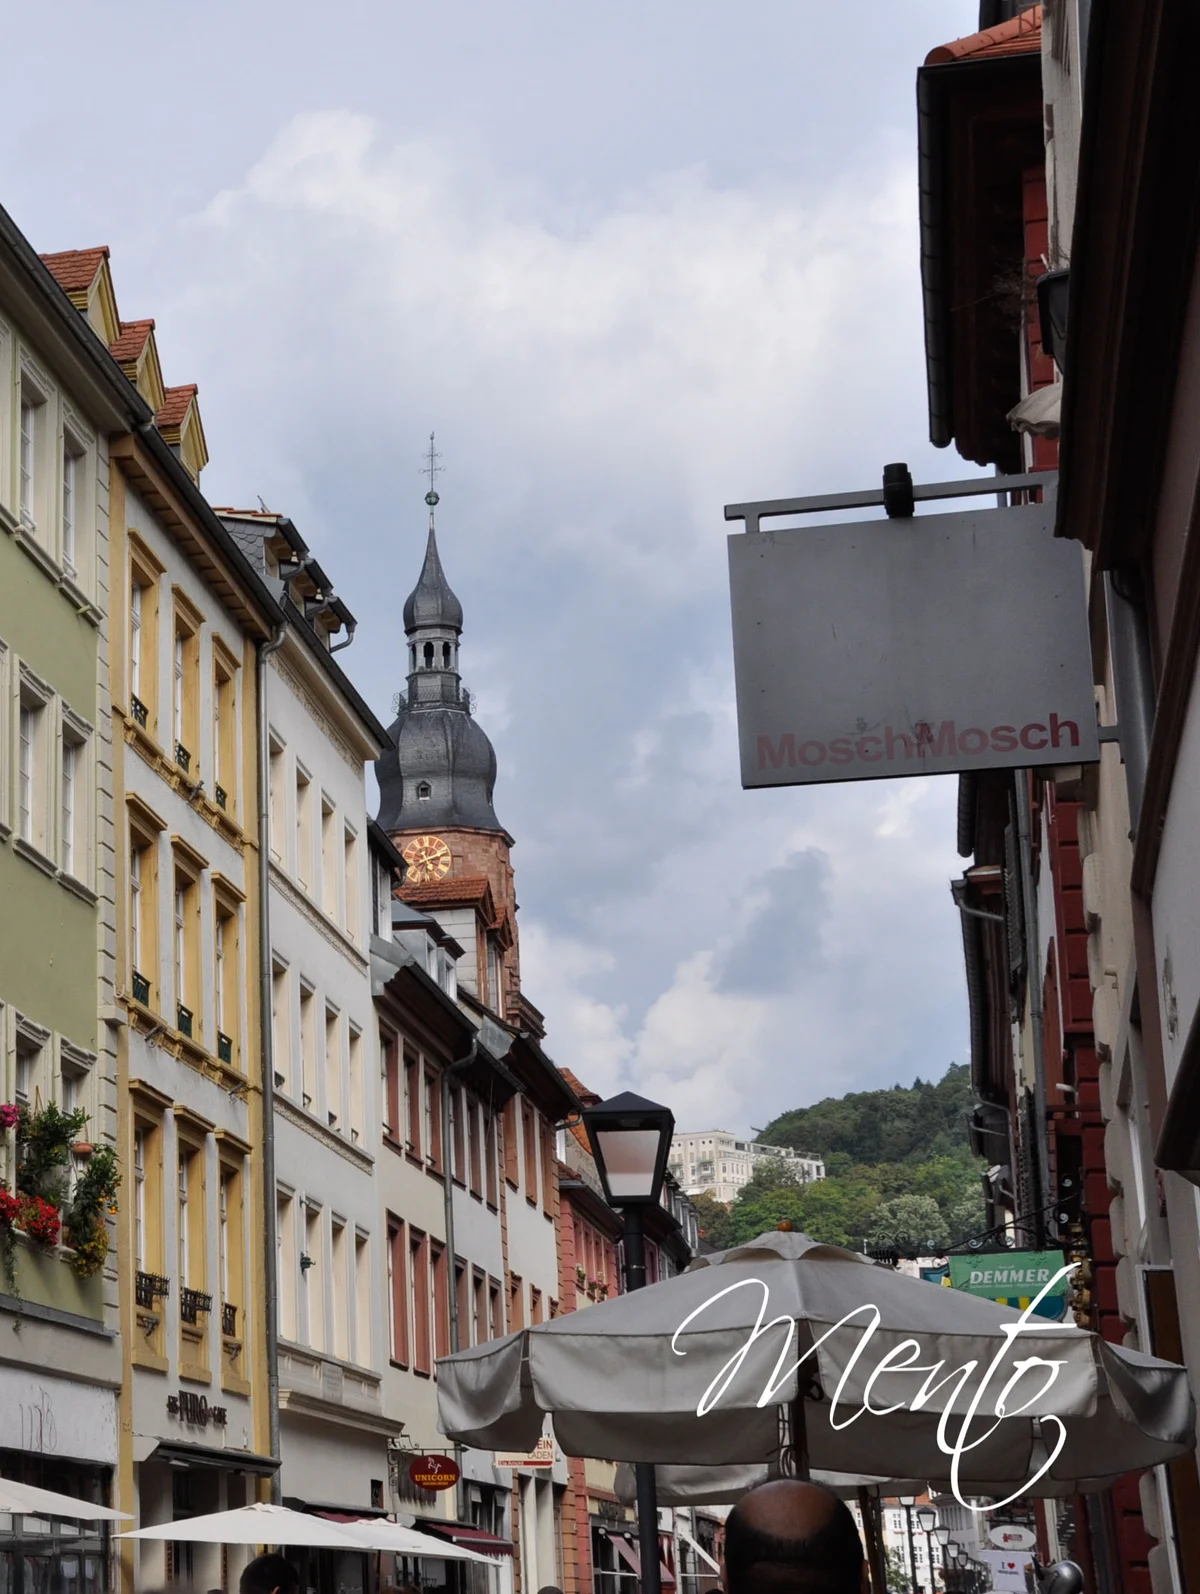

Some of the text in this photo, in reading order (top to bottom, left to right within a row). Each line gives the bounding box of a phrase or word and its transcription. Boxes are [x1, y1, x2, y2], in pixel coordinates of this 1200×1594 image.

[756, 712, 1081, 771] MoschMosch
[969, 1268, 1050, 1285] DEMMER
[415, 1474, 456, 1482] UNICORN
